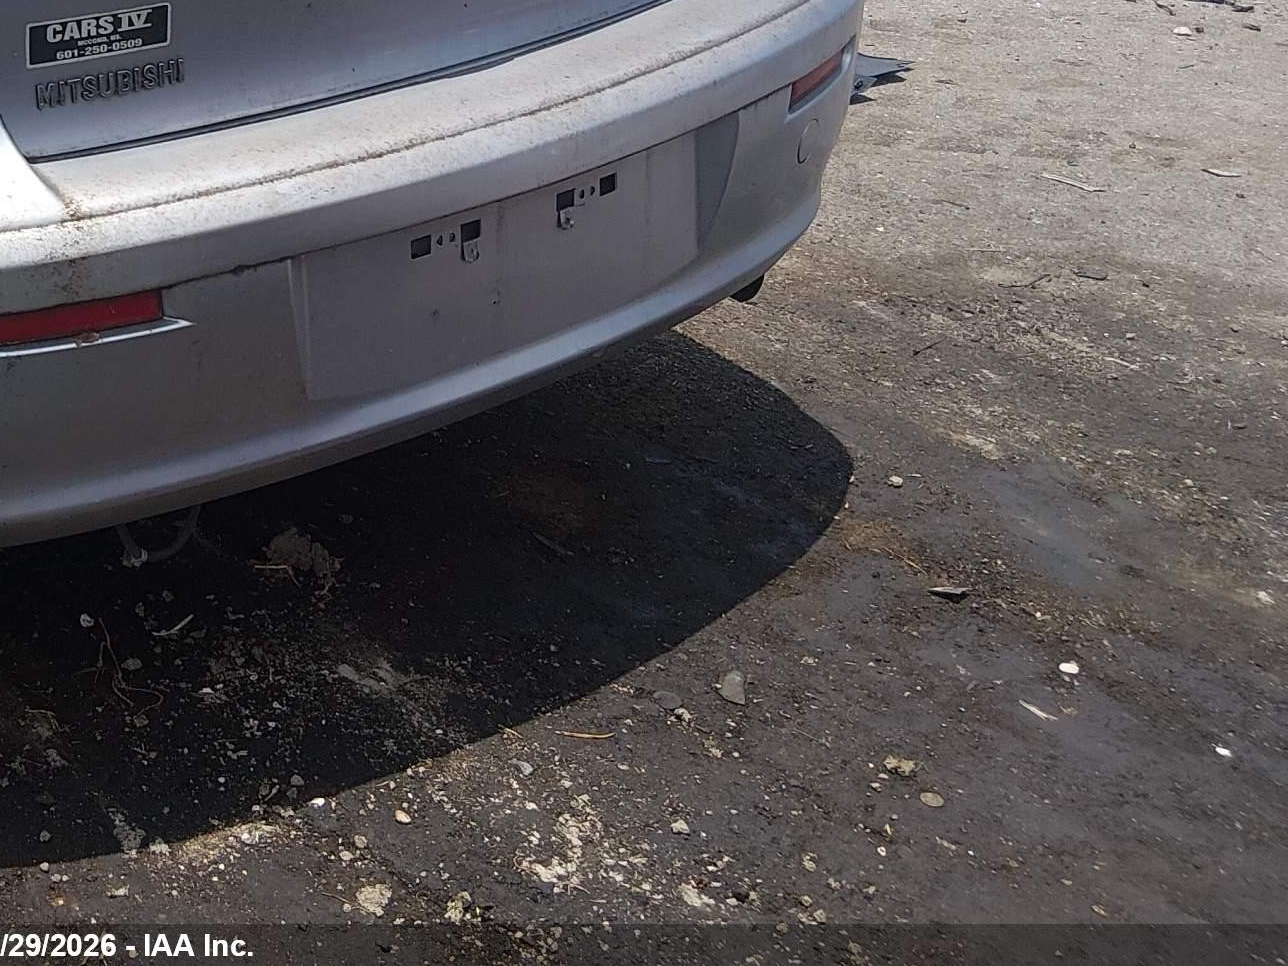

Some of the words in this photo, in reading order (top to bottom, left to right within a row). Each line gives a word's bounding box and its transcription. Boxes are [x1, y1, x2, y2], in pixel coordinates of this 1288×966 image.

[46, 15, 114, 43] CARS
[117, 9, 153, 32] IV
[56, 38, 143, 60] 601-250-0509
[35, 59, 185, 111] MITSUBISHI
